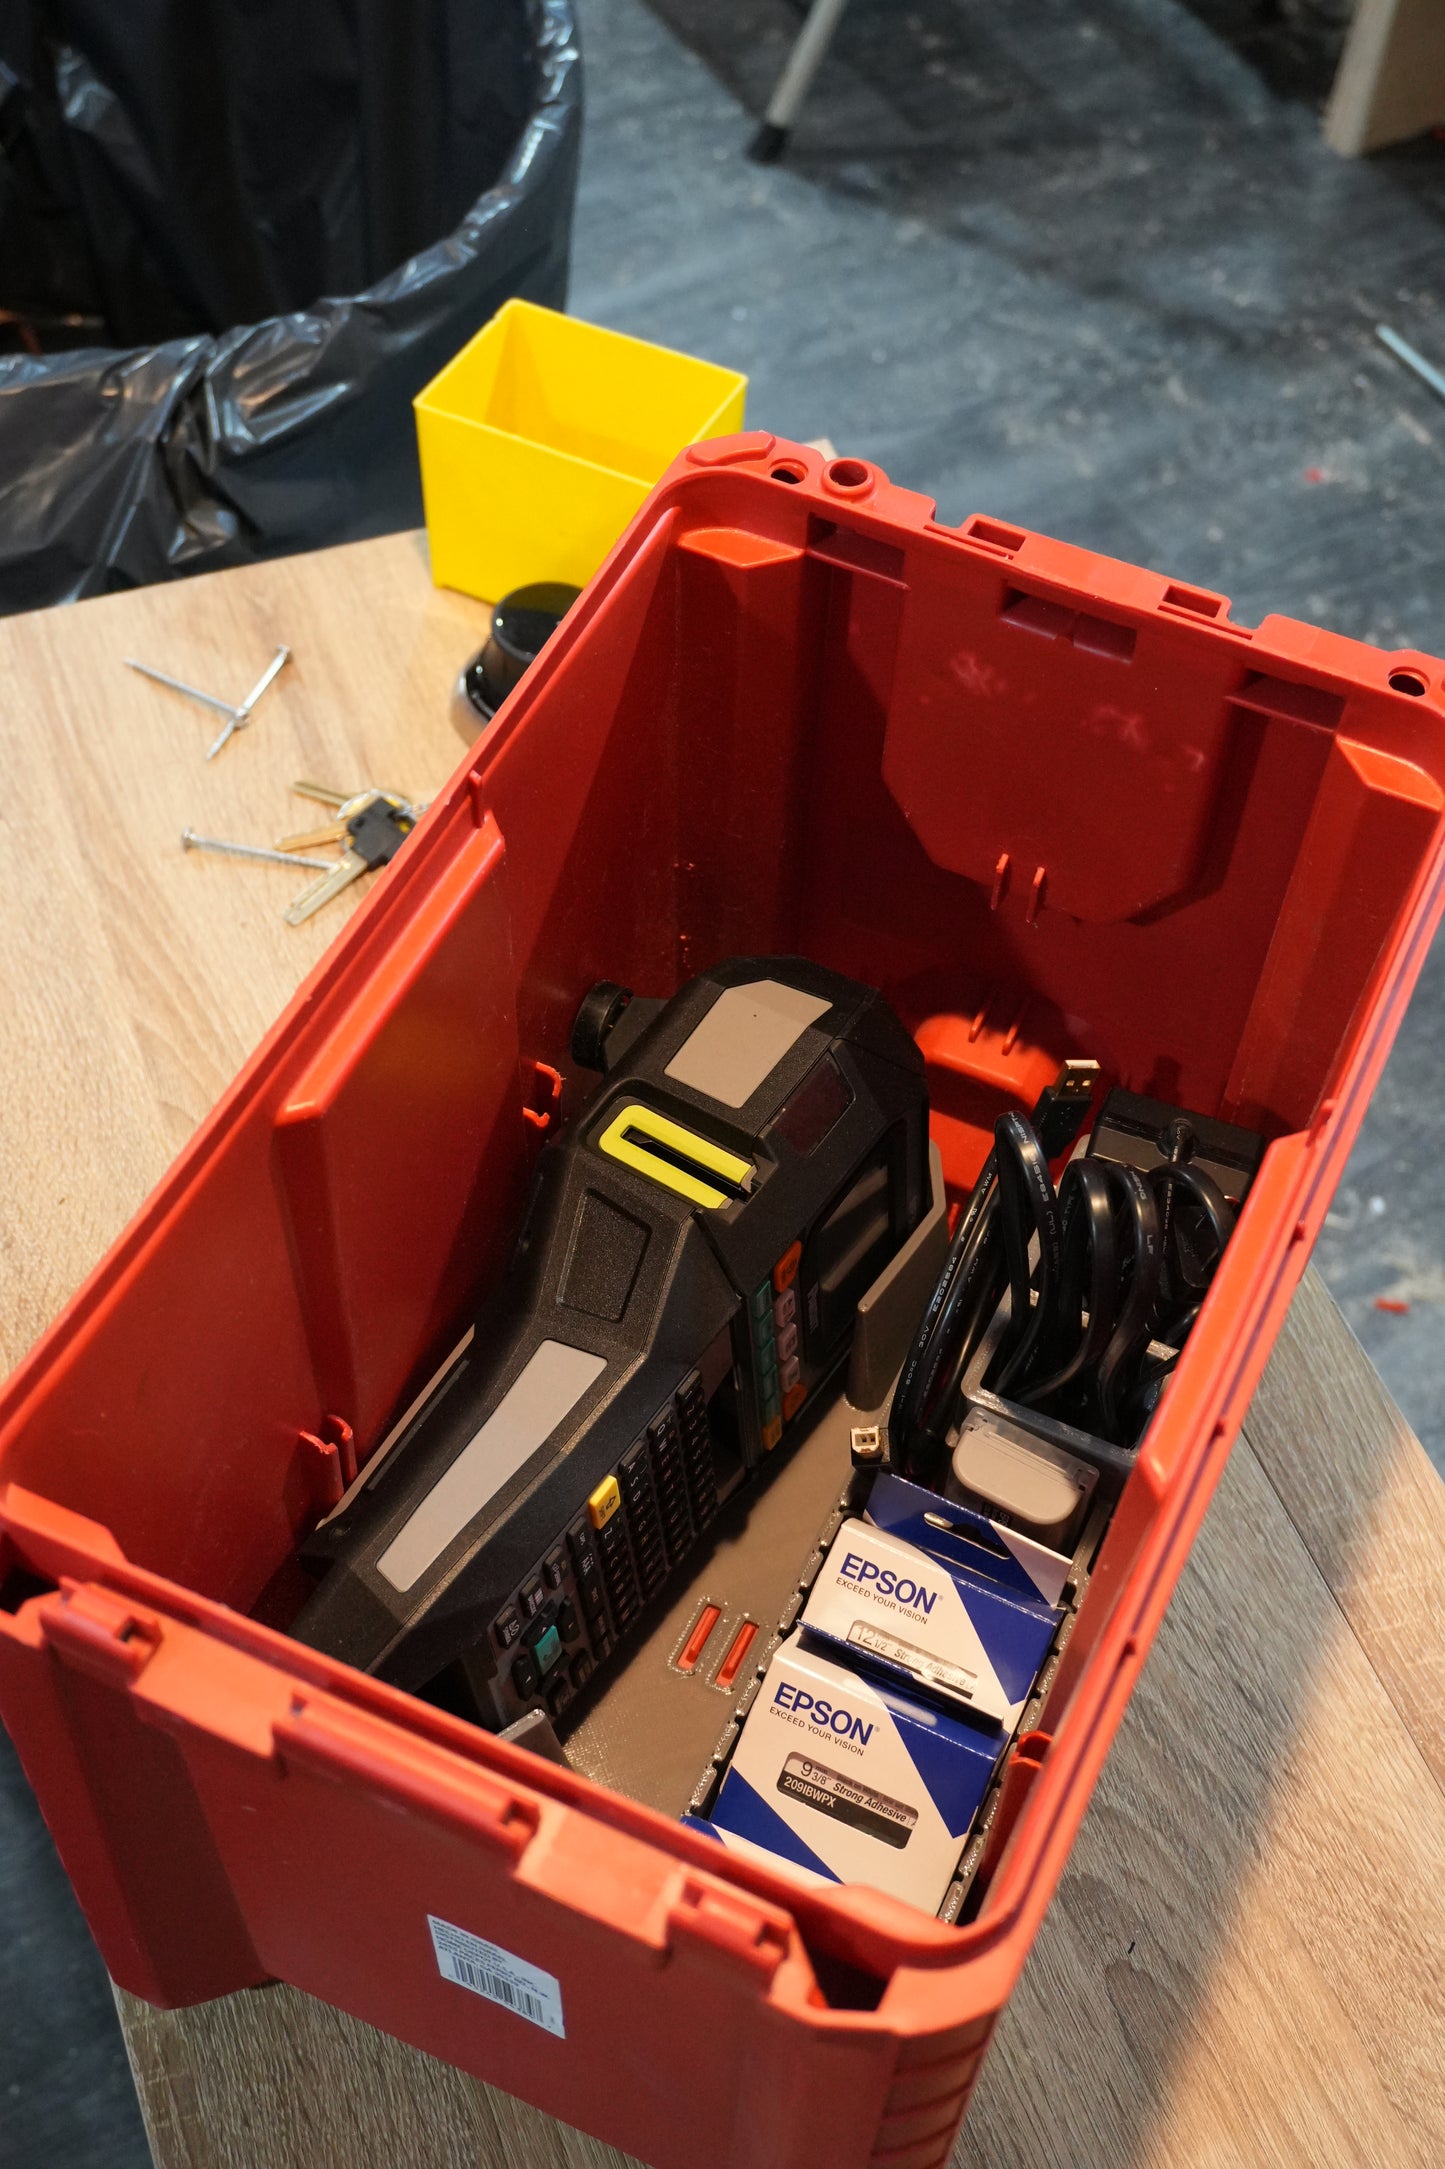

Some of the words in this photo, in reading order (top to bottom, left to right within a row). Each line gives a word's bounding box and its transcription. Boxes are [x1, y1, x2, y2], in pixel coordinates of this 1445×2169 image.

[836, 1576, 872, 1598] EXCEED
[872, 1593, 898, 1611] YOUR
[898, 1605, 929, 1626] VISION
[840, 1552, 938, 1615] EPSON
[769, 1706, 806, 1728] EXCEED
[807, 1723, 832, 1742] YOUR
[834, 1736, 865, 1757] VISION
[774, 1681, 874, 1746] EPSON
[800, 1761, 813, 1778] 9
[832, 1782, 864, 1804] Strong
[863, 1796, 907, 1823] Adhesive
